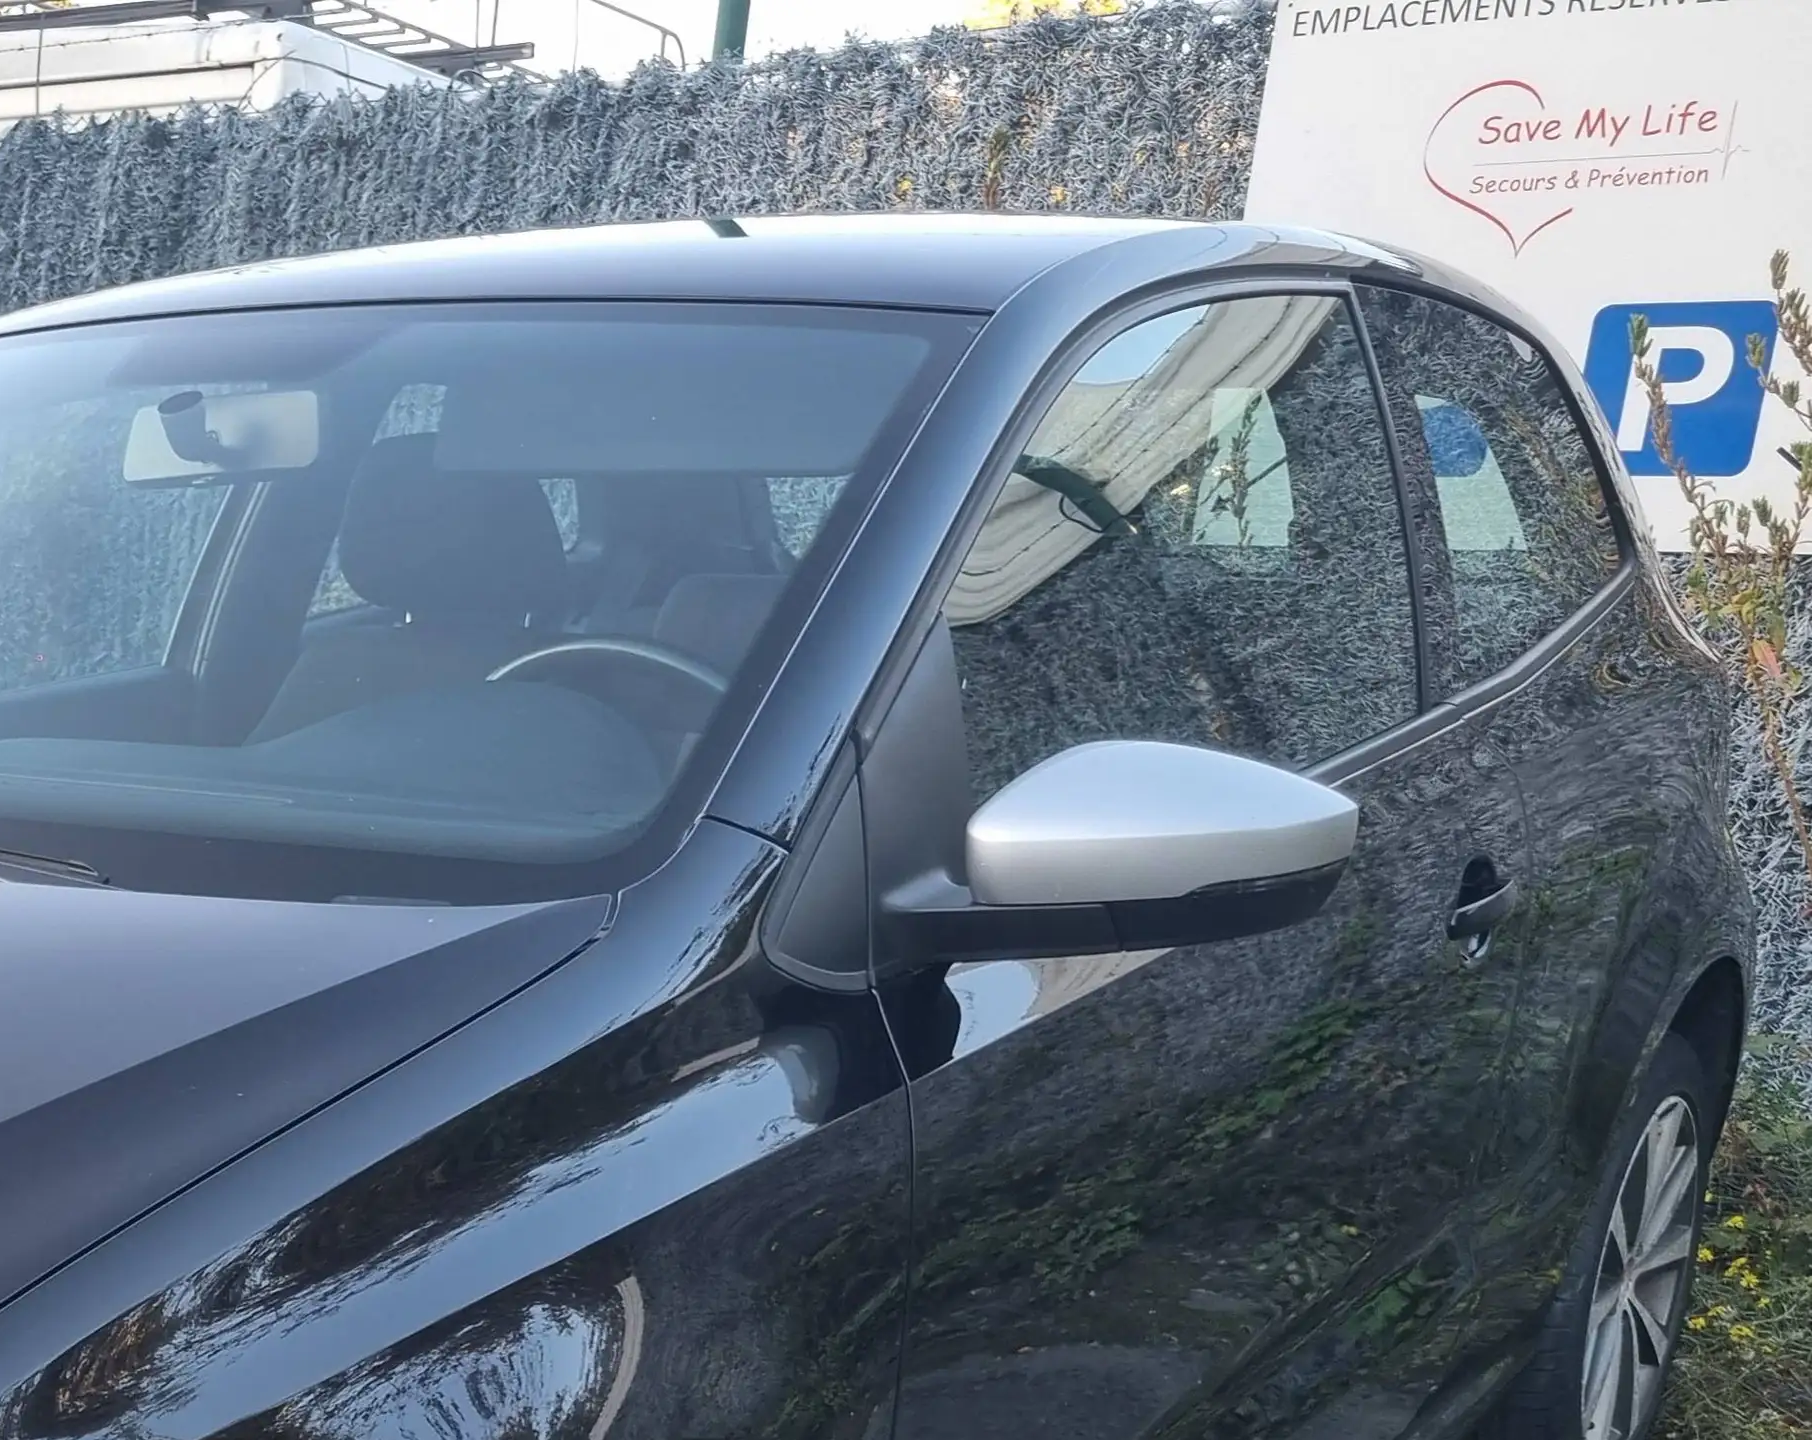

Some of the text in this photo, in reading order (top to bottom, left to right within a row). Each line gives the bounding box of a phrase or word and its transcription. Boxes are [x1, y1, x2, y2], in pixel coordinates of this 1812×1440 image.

[1292, 0, 1556, 37] EMPLACEMENTS
[1478, 100, 1718, 147] Save My Life
[1468, 166, 1709, 195] Secours & Prévention
[1615, 325, 1735, 452] P
